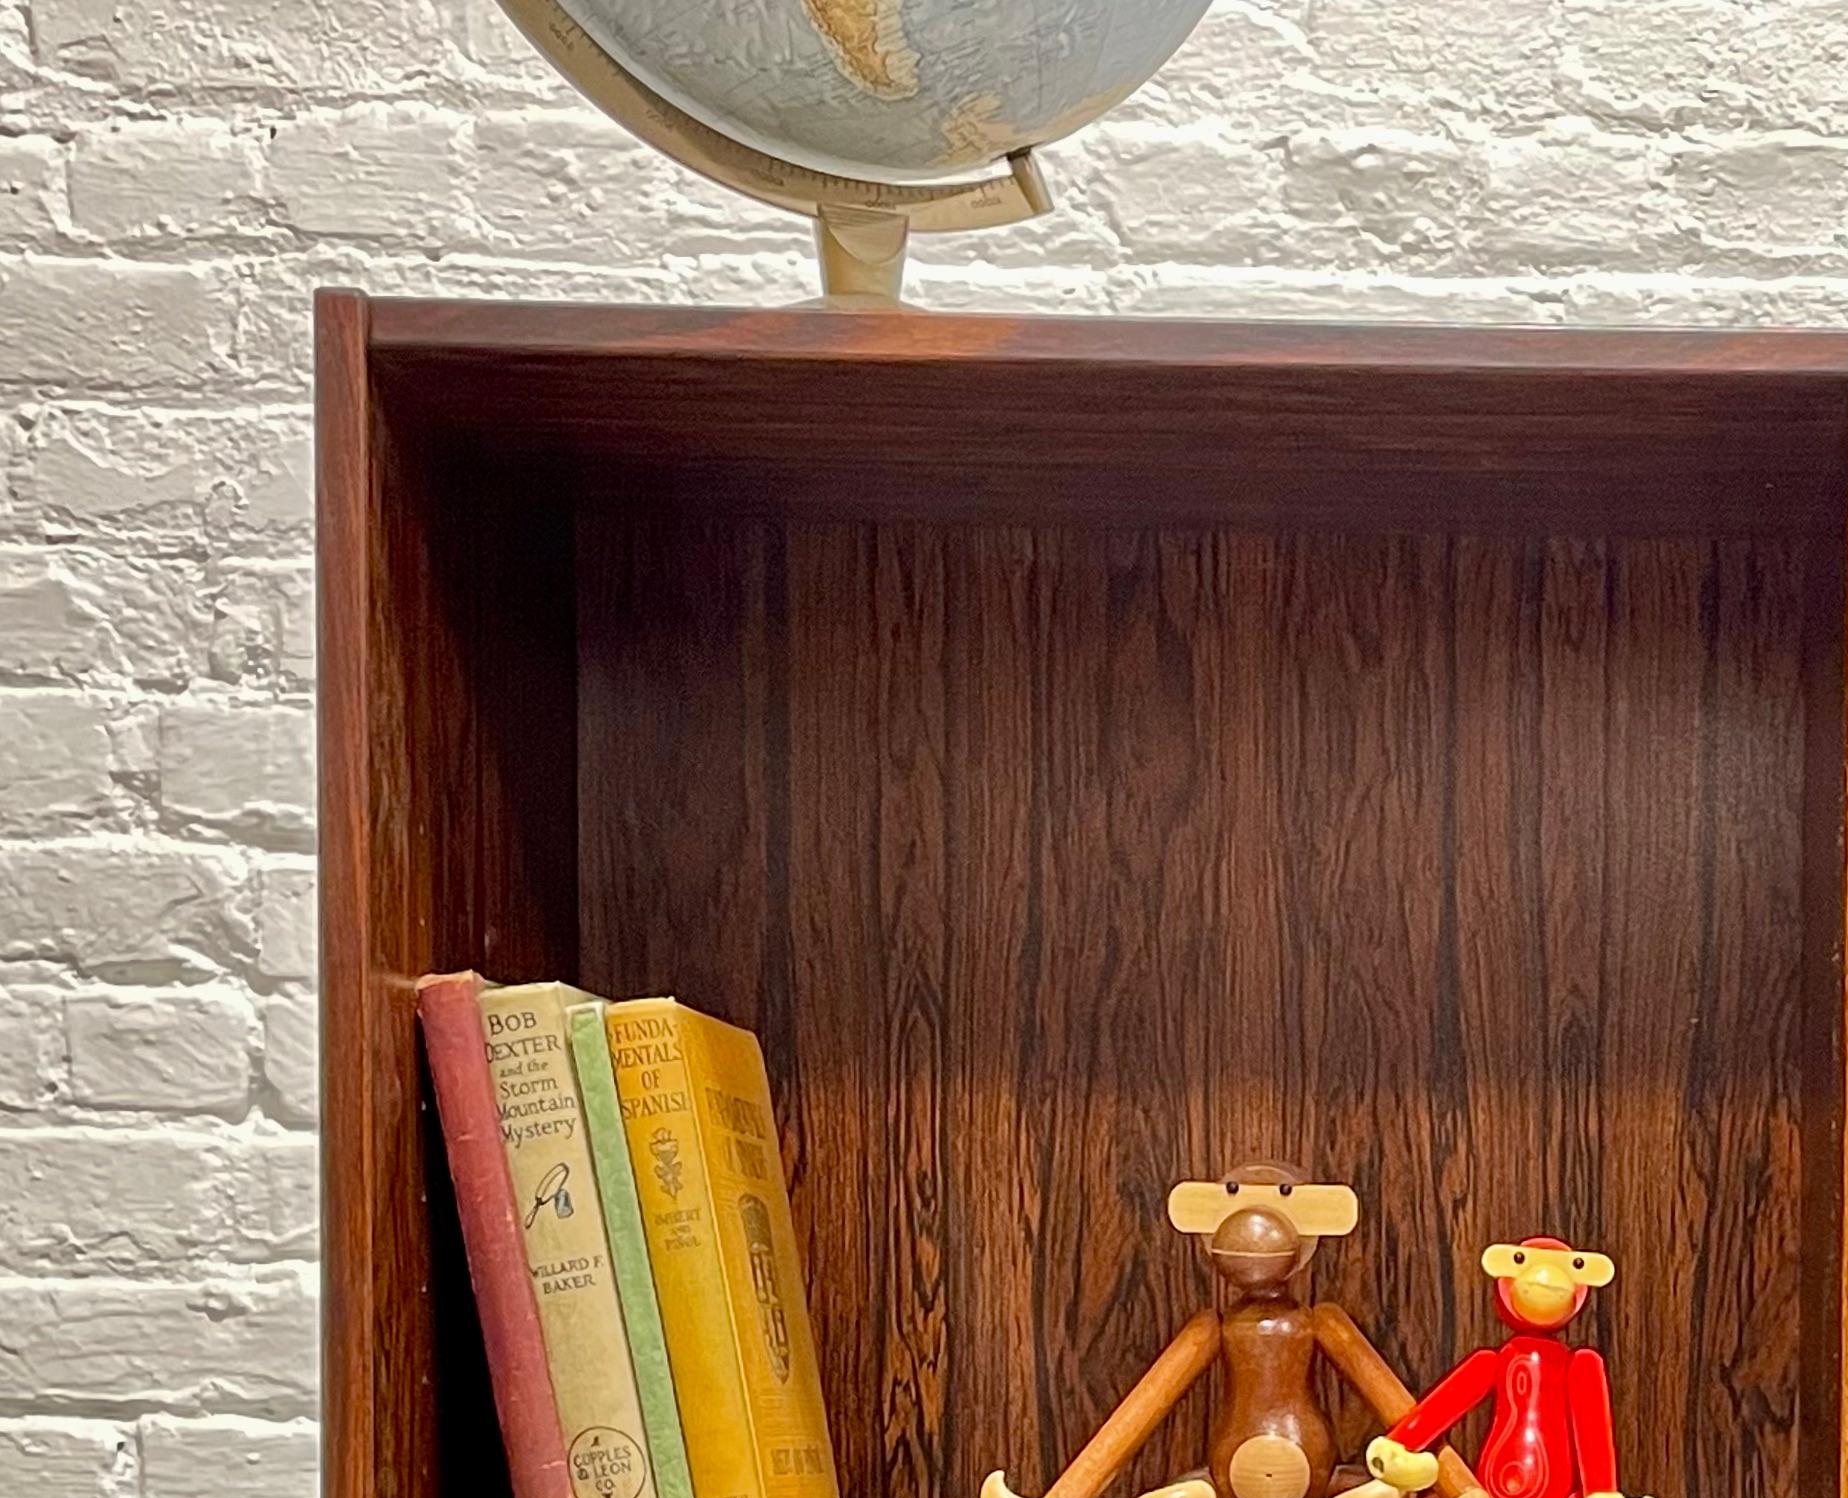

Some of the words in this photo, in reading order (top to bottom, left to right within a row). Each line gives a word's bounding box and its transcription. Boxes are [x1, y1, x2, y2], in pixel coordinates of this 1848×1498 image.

[487, 1011, 537, 1036] BOB
[484, 1034, 562, 1064] DEXTER
[500, 1061, 523, 1078] and
[527, 1060, 549, 1073] the
[641, 1070, 661, 1090] OF
[499, 1077, 559, 1100] Storm
[496, 1094, 577, 1121] Mountain
[500, 1117, 577, 1149] Mystery
[542, 1273, 596, 1295] BAKER
[573, 1445, 632, 1467] CUPPLES
[593, 1460, 632, 1479] LEON
